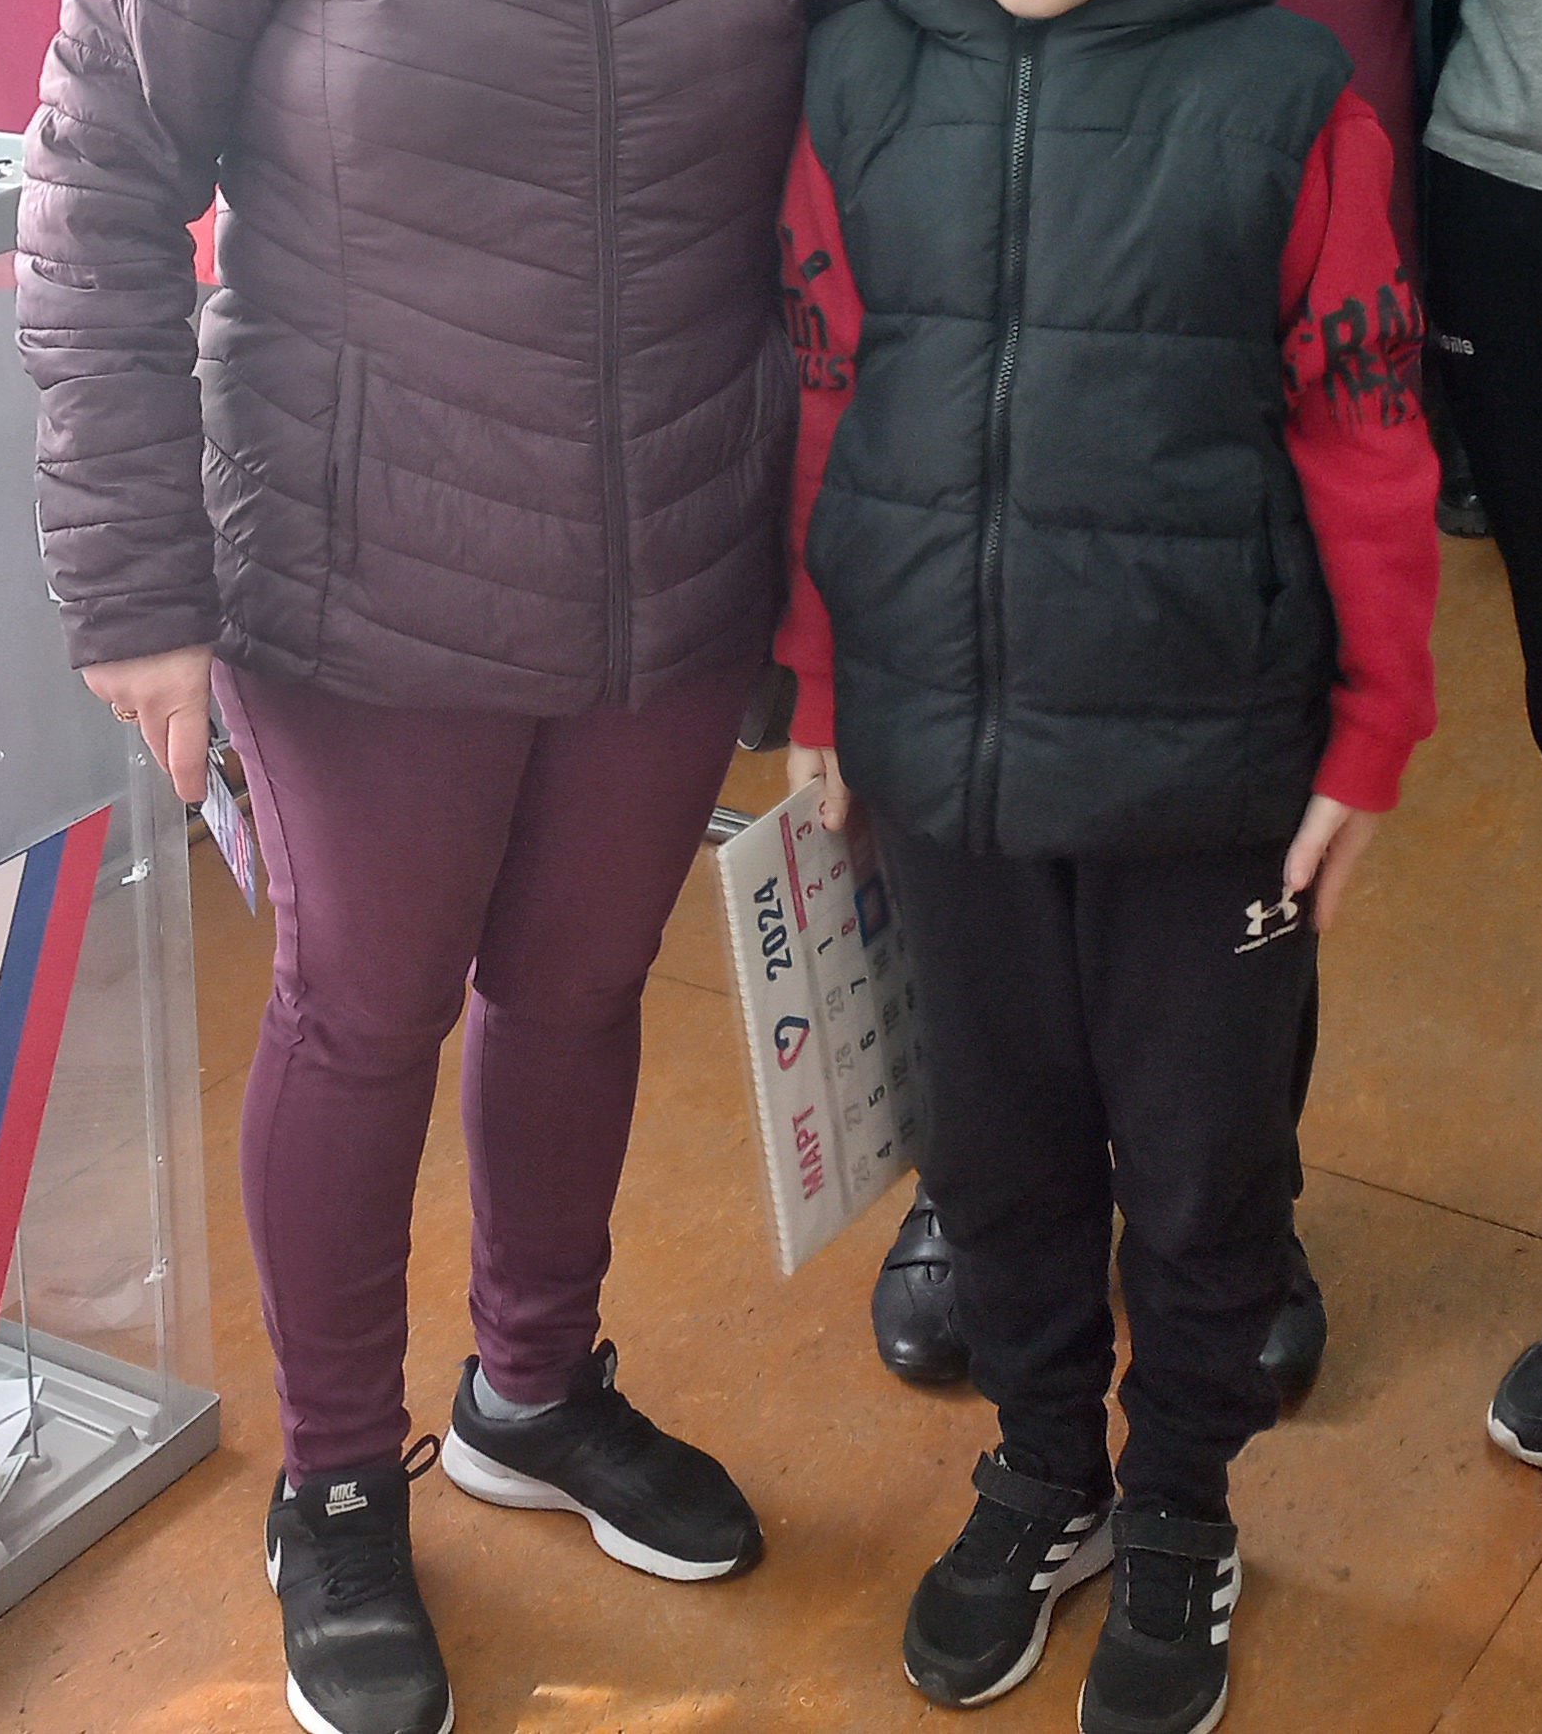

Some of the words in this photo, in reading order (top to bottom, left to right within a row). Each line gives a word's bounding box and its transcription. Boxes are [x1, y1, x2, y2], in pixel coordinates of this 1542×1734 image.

[796, 820, 812, 841] 3
[830, 860, 846, 880] 9
[806, 878, 823, 899] 2
[754, 876, 792, 981] 2024
[841, 917, 856, 937] 8
[816, 936, 834, 955] 1
[850, 975, 868, 994] 7
[859, 1029, 876, 1051] 6
[868, 1084, 887, 1108] 5
[792, 1105, 824, 1200] МАРТ
[876, 1140, 893, 1158] 4
[329, 1480, 358, 1503] NIKE
